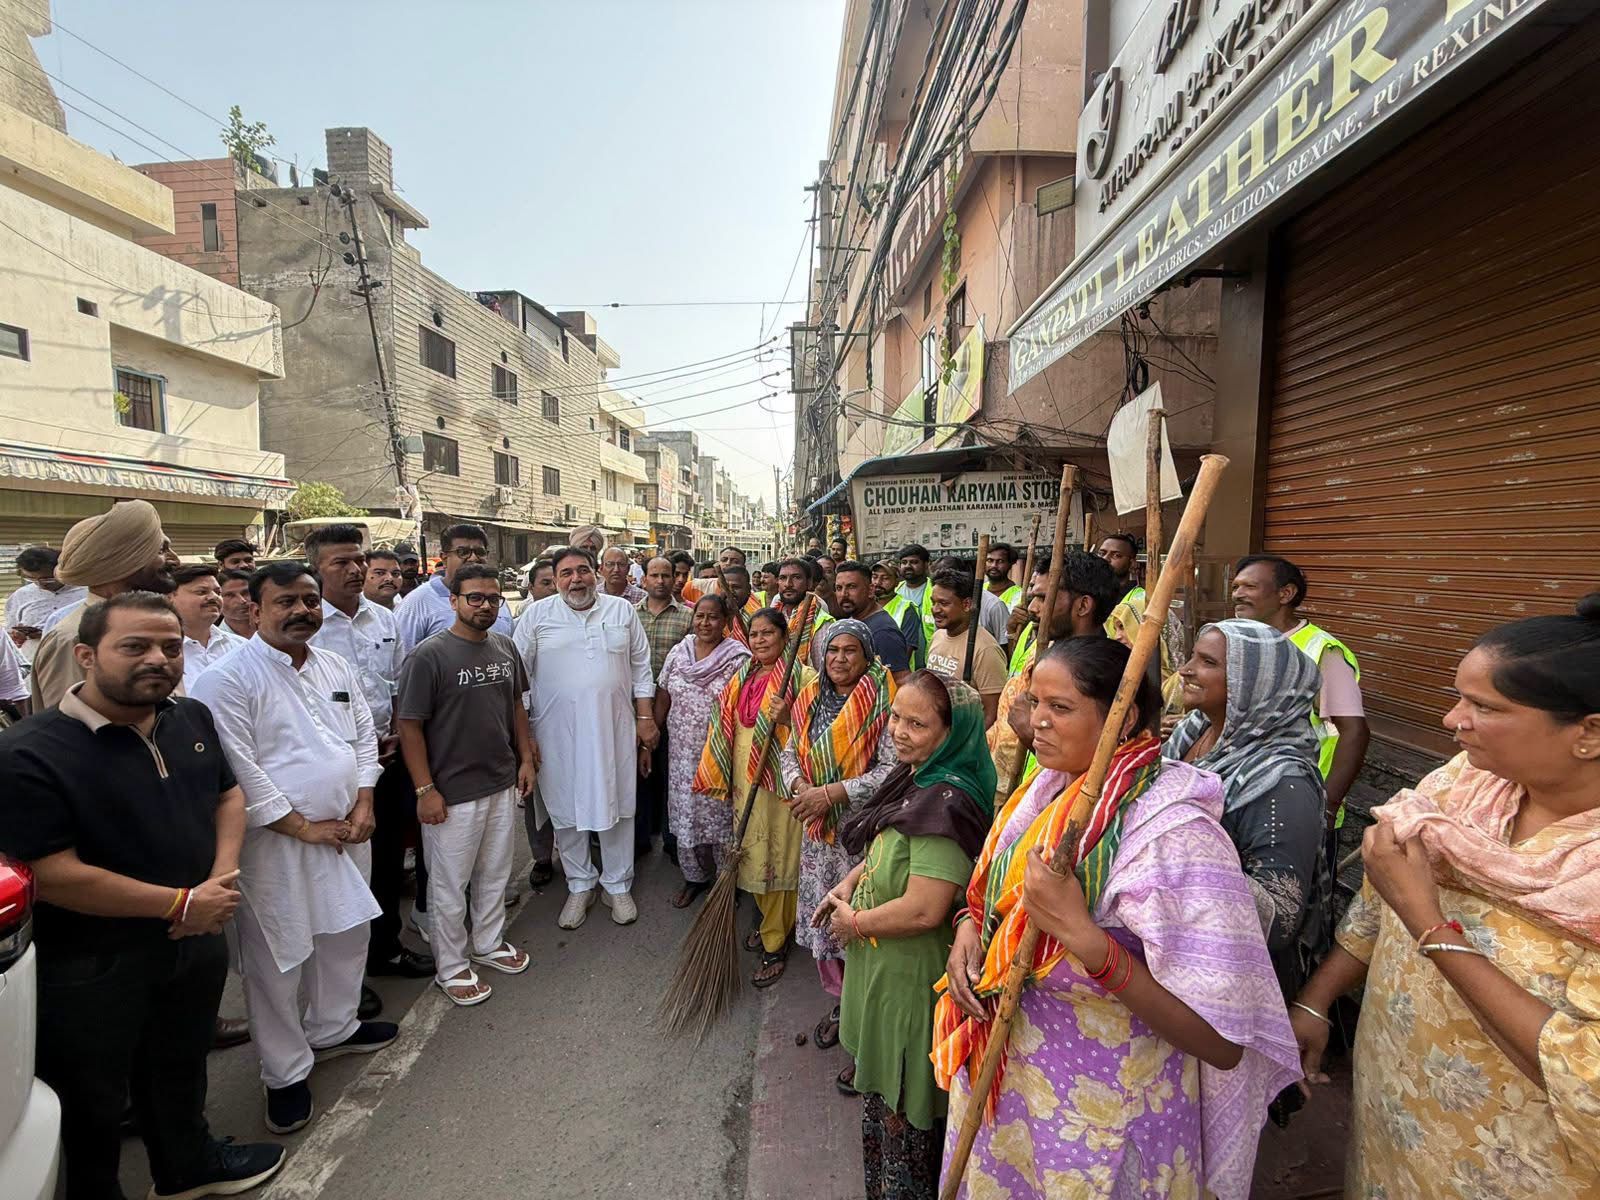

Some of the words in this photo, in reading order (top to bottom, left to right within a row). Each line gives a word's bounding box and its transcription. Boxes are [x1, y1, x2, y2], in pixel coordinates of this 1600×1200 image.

[1157, 235, 1204, 279] FABRICS,
[1207, 176, 1280, 243] SOLUTION,
[1286, 112, 1362, 182] REXINE,
[1371, 74, 1404, 117] PU
[1411, 0, 1528, 88] REXIN
[1015, 266, 1104, 371] GANPATI
[1113, 6, 1397, 293] LEATHER
[864, 485, 941, 508] CHOUHAN
[946, 481, 1018, 503] KARYANA
[1022, 480, 1061, 501] STOR
[920, 504, 964, 513] RAJASTHANI
[966, 503, 1004, 511] KARAYANA
[1006, 501, 1028, 509] ITEMS
[457, 661, 512, 686] から学ぶ
